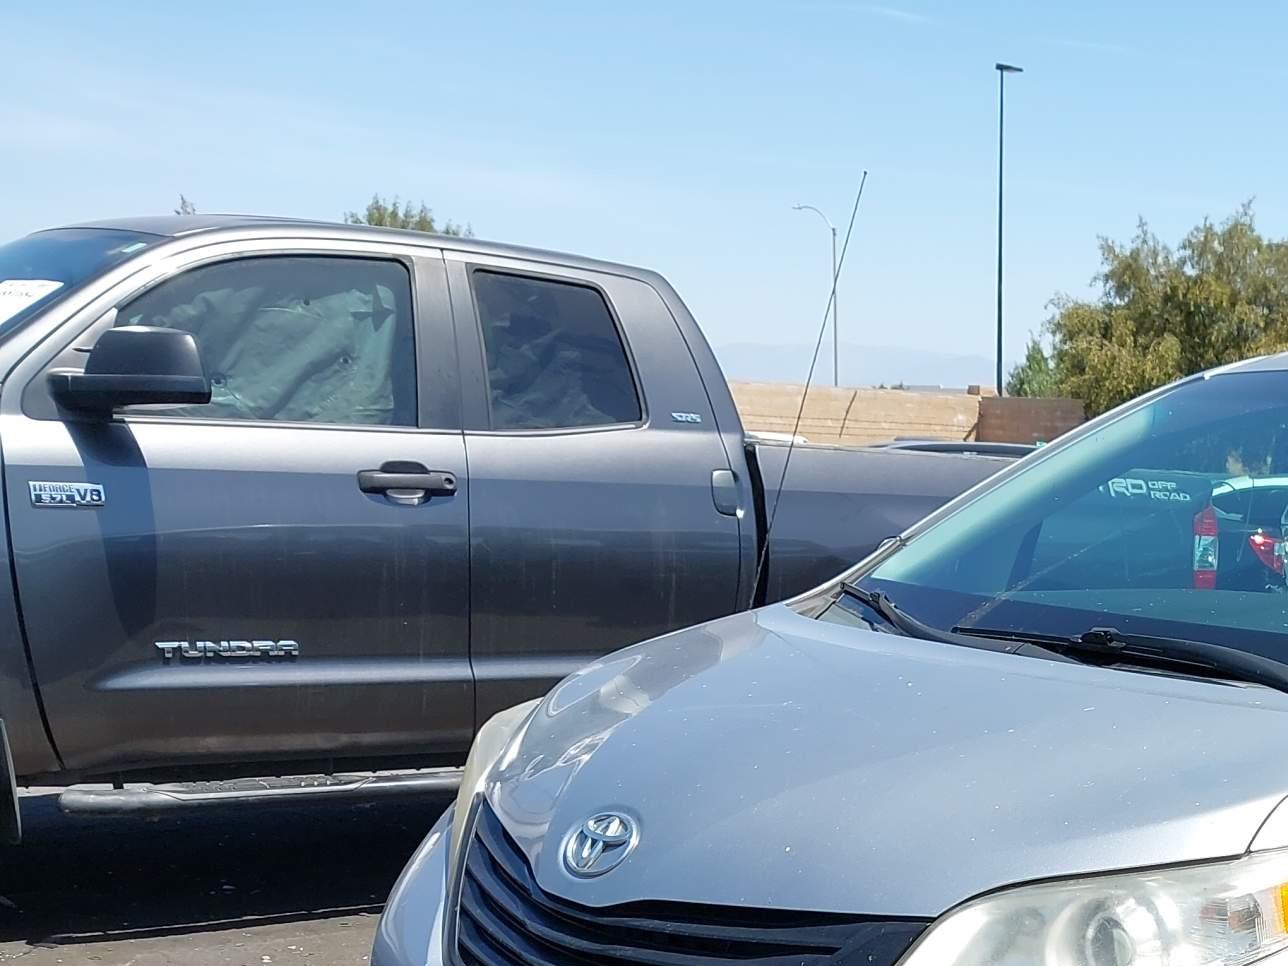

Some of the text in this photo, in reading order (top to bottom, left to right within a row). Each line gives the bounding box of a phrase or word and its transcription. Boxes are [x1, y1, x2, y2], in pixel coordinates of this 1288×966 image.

[1148, 481, 1177, 490] OFF
[76, 488, 102, 503] V8
[1150, 490, 1191, 501] ROAD
[154, 640, 299, 658] TUNDRA
